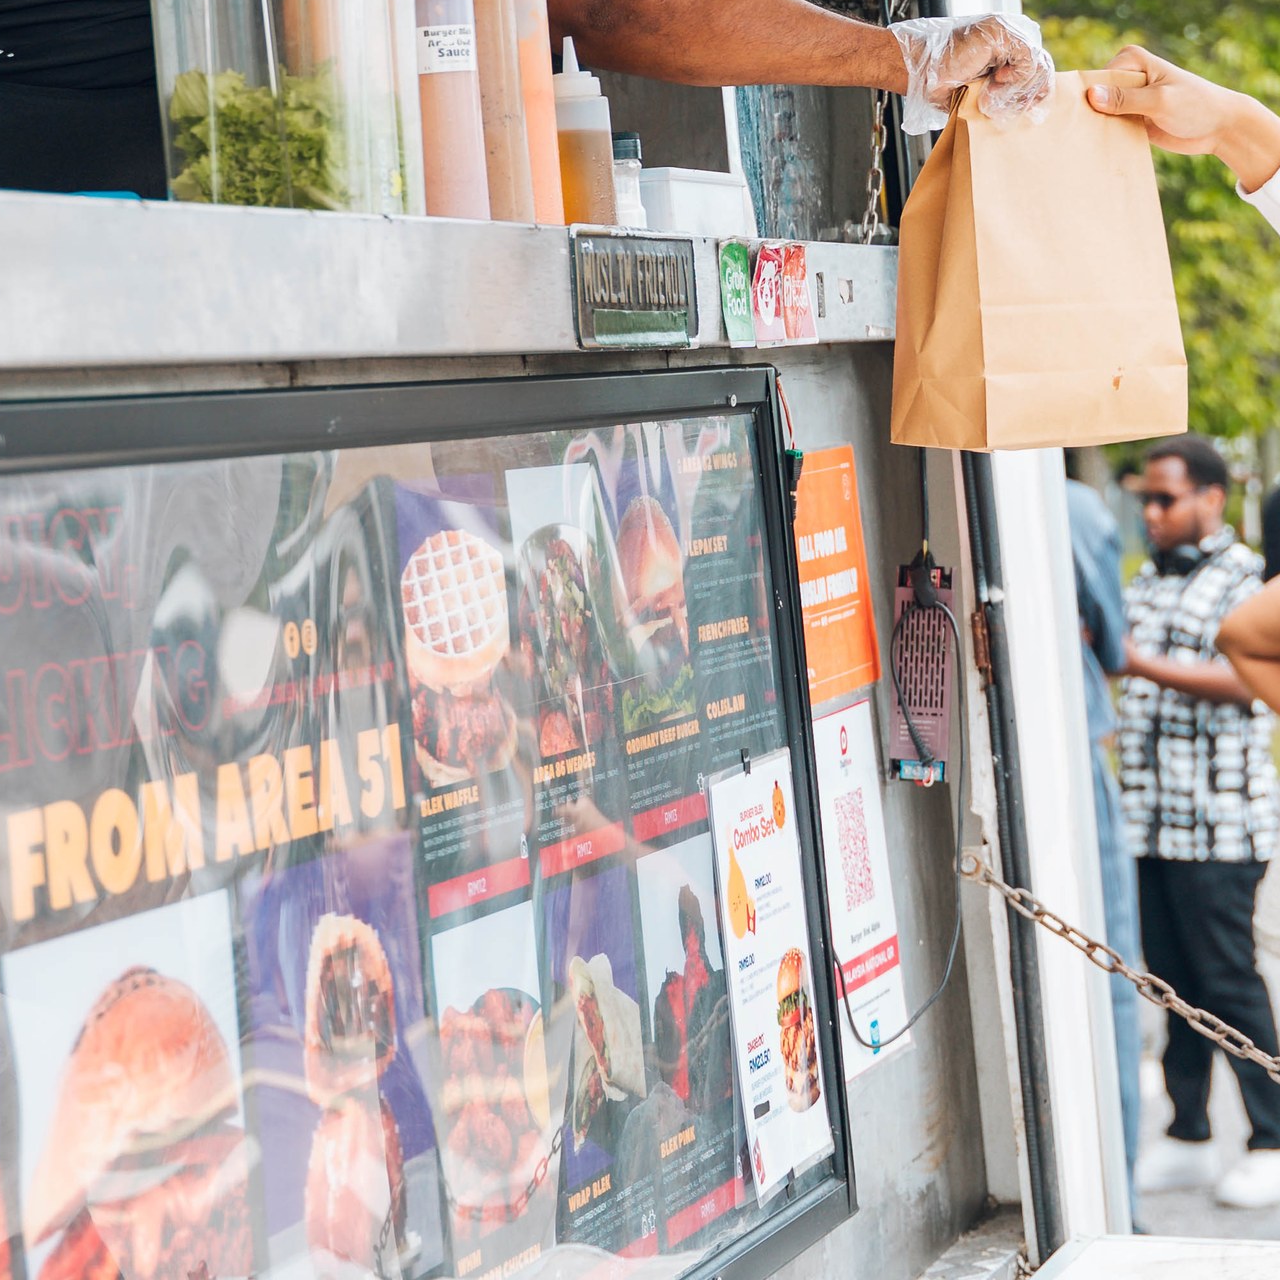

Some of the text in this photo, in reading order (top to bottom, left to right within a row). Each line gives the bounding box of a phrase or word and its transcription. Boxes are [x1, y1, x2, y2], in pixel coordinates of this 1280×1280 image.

[437, 47, 471, 58] Sauce
[726, 293, 747, 316] Food
[443, 784, 480, 811] WAFFLE
[6, 771, 205, 922] FROM
[213, 737, 353, 864] AREA
[357, 722, 407, 818] 51
[733, 813, 775, 850] Combo Set
[568, 1173, 612, 1213] WRAP BLEK
